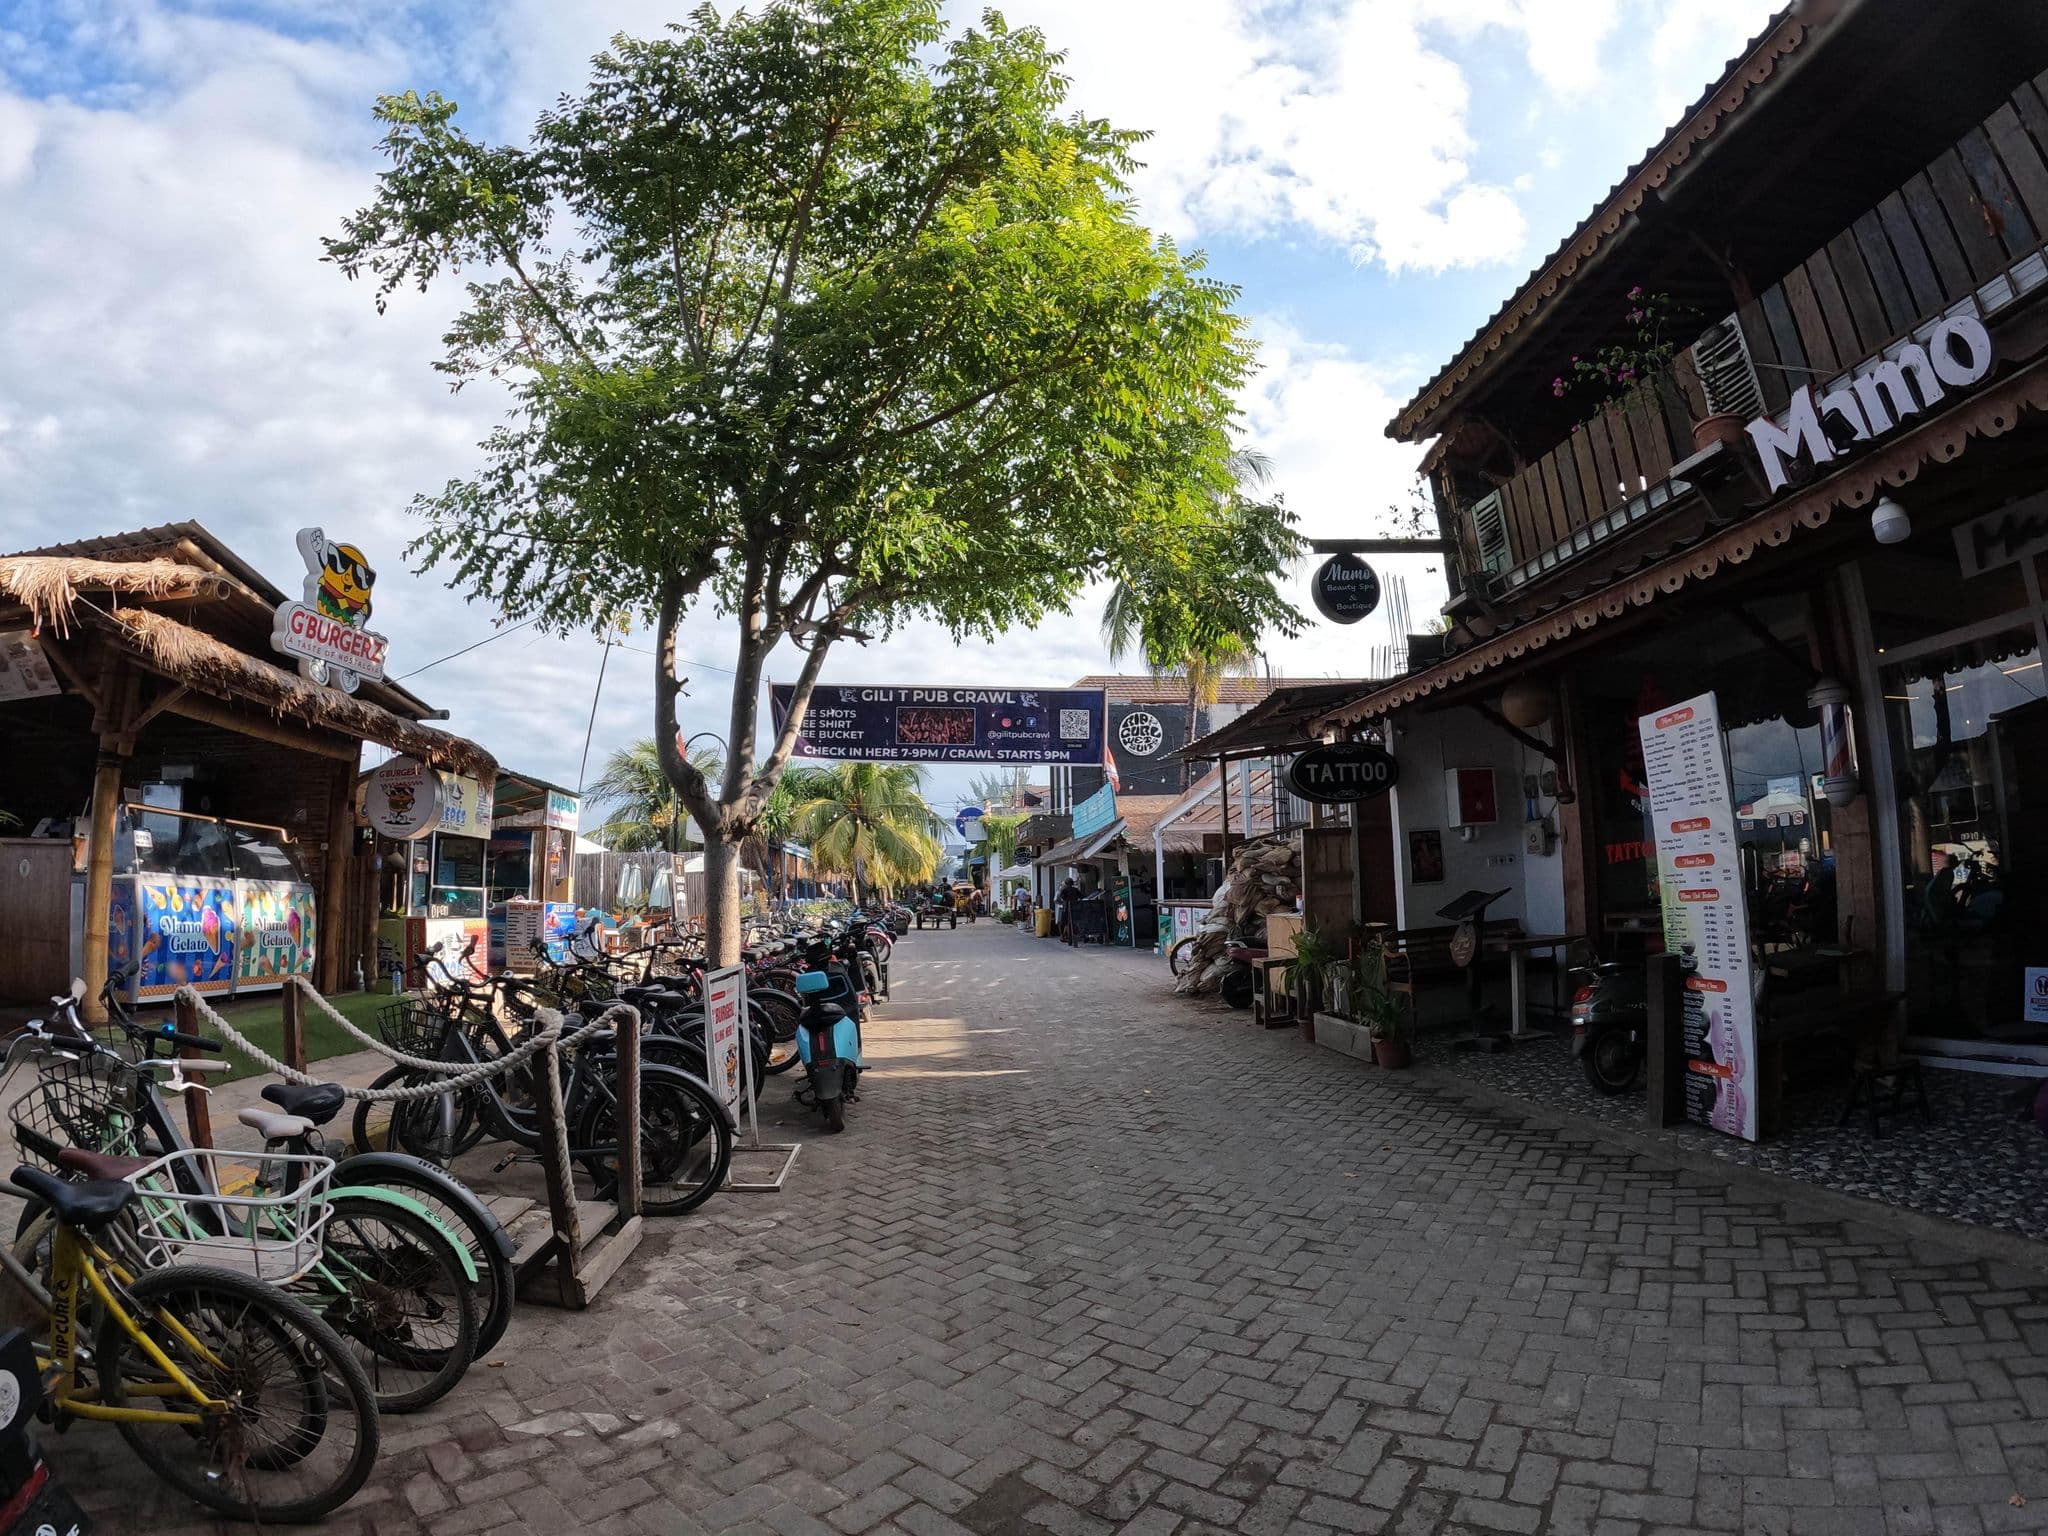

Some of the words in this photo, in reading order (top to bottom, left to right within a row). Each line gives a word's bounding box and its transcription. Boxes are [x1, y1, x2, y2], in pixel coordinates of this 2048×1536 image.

[1745, 315, 1992, 495] Mamo
[1323, 563, 1371, 582] Mamo
[1327, 584, 1356, 593] Beauty
[1359, 583, 1374, 591] Spa
[1336, 602, 1372, 611] Boutique
[291, 610, 384, 663] G'BURGERZ
[297, 639, 321, 654] TASTE
[324, 649, 335, 658] OF
[861, 689, 893, 702] GILI
[898, 689, 909, 702] T
[913, 690, 948, 703] PUB
[953, 691, 1016, 703] CRAWL
[820, 709, 857, 718] SHOTS
[819, 720, 852, 729] SHIRT
[819, 731, 864, 739] BUCKET
[987, 730, 1050, 740] @gilitpubcrawl
[1120, 725, 1161, 739] CURL
[803, 745, 846, 756] CHECK
[849, 747, 861, 757] IN
[865, 748, 898, 757] HERE
[901, 748, 938, 758] 7-9PM
[949, 749, 994, 759] CRAWL
[997, 750, 1041, 760] STARTS
[1044, 751, 1070, 760] 9PM
[1305, 762, 1387, 783] TATTOO
[161, 915, 201, 936] Mamo
[256, 916, 288, 932] Mamo
[171, 935, 208, 951] Gelato
[262, 933, 293, 947] Gelato
